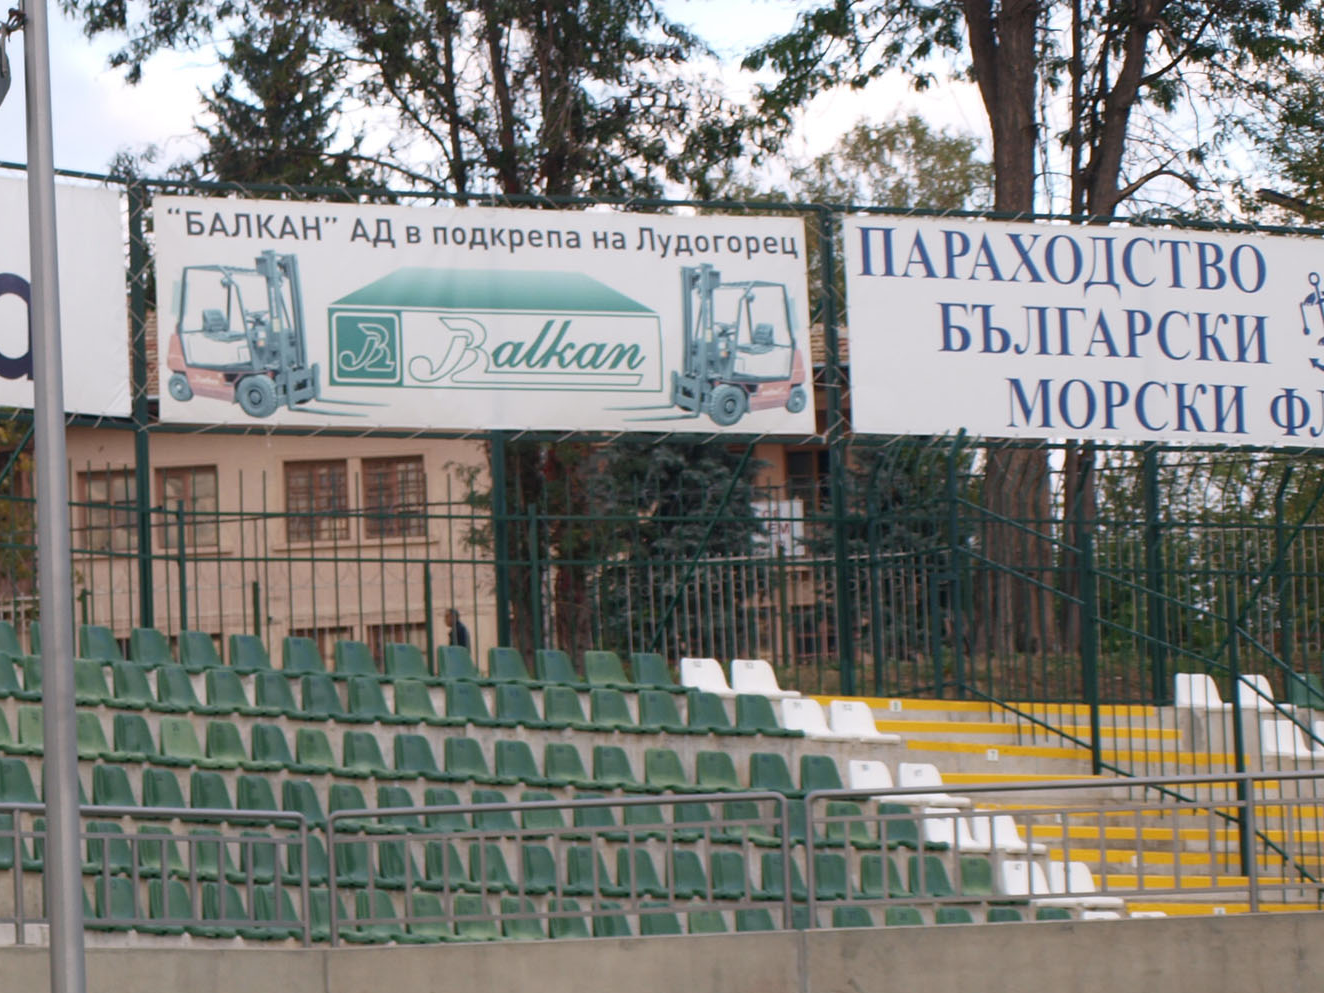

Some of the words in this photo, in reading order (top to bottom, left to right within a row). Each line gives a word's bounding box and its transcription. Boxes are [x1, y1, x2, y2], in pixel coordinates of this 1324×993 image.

[350, 217, 396, 249] АД
[406, 226, 420, 243] в
[433, 226, 581, 252] подкрепа
[592, 229, 626, 250] на
[636, 227, 798, 259] Лудогорец
[859, 226, 1267, 294] ПАРАХОДСТВО
[409, 317, 647, 383] Balkan
[940, 302, 1271, 364] БЪЛГАРСКИ
[1009, 378, 1249, 434] МОРСКИ
